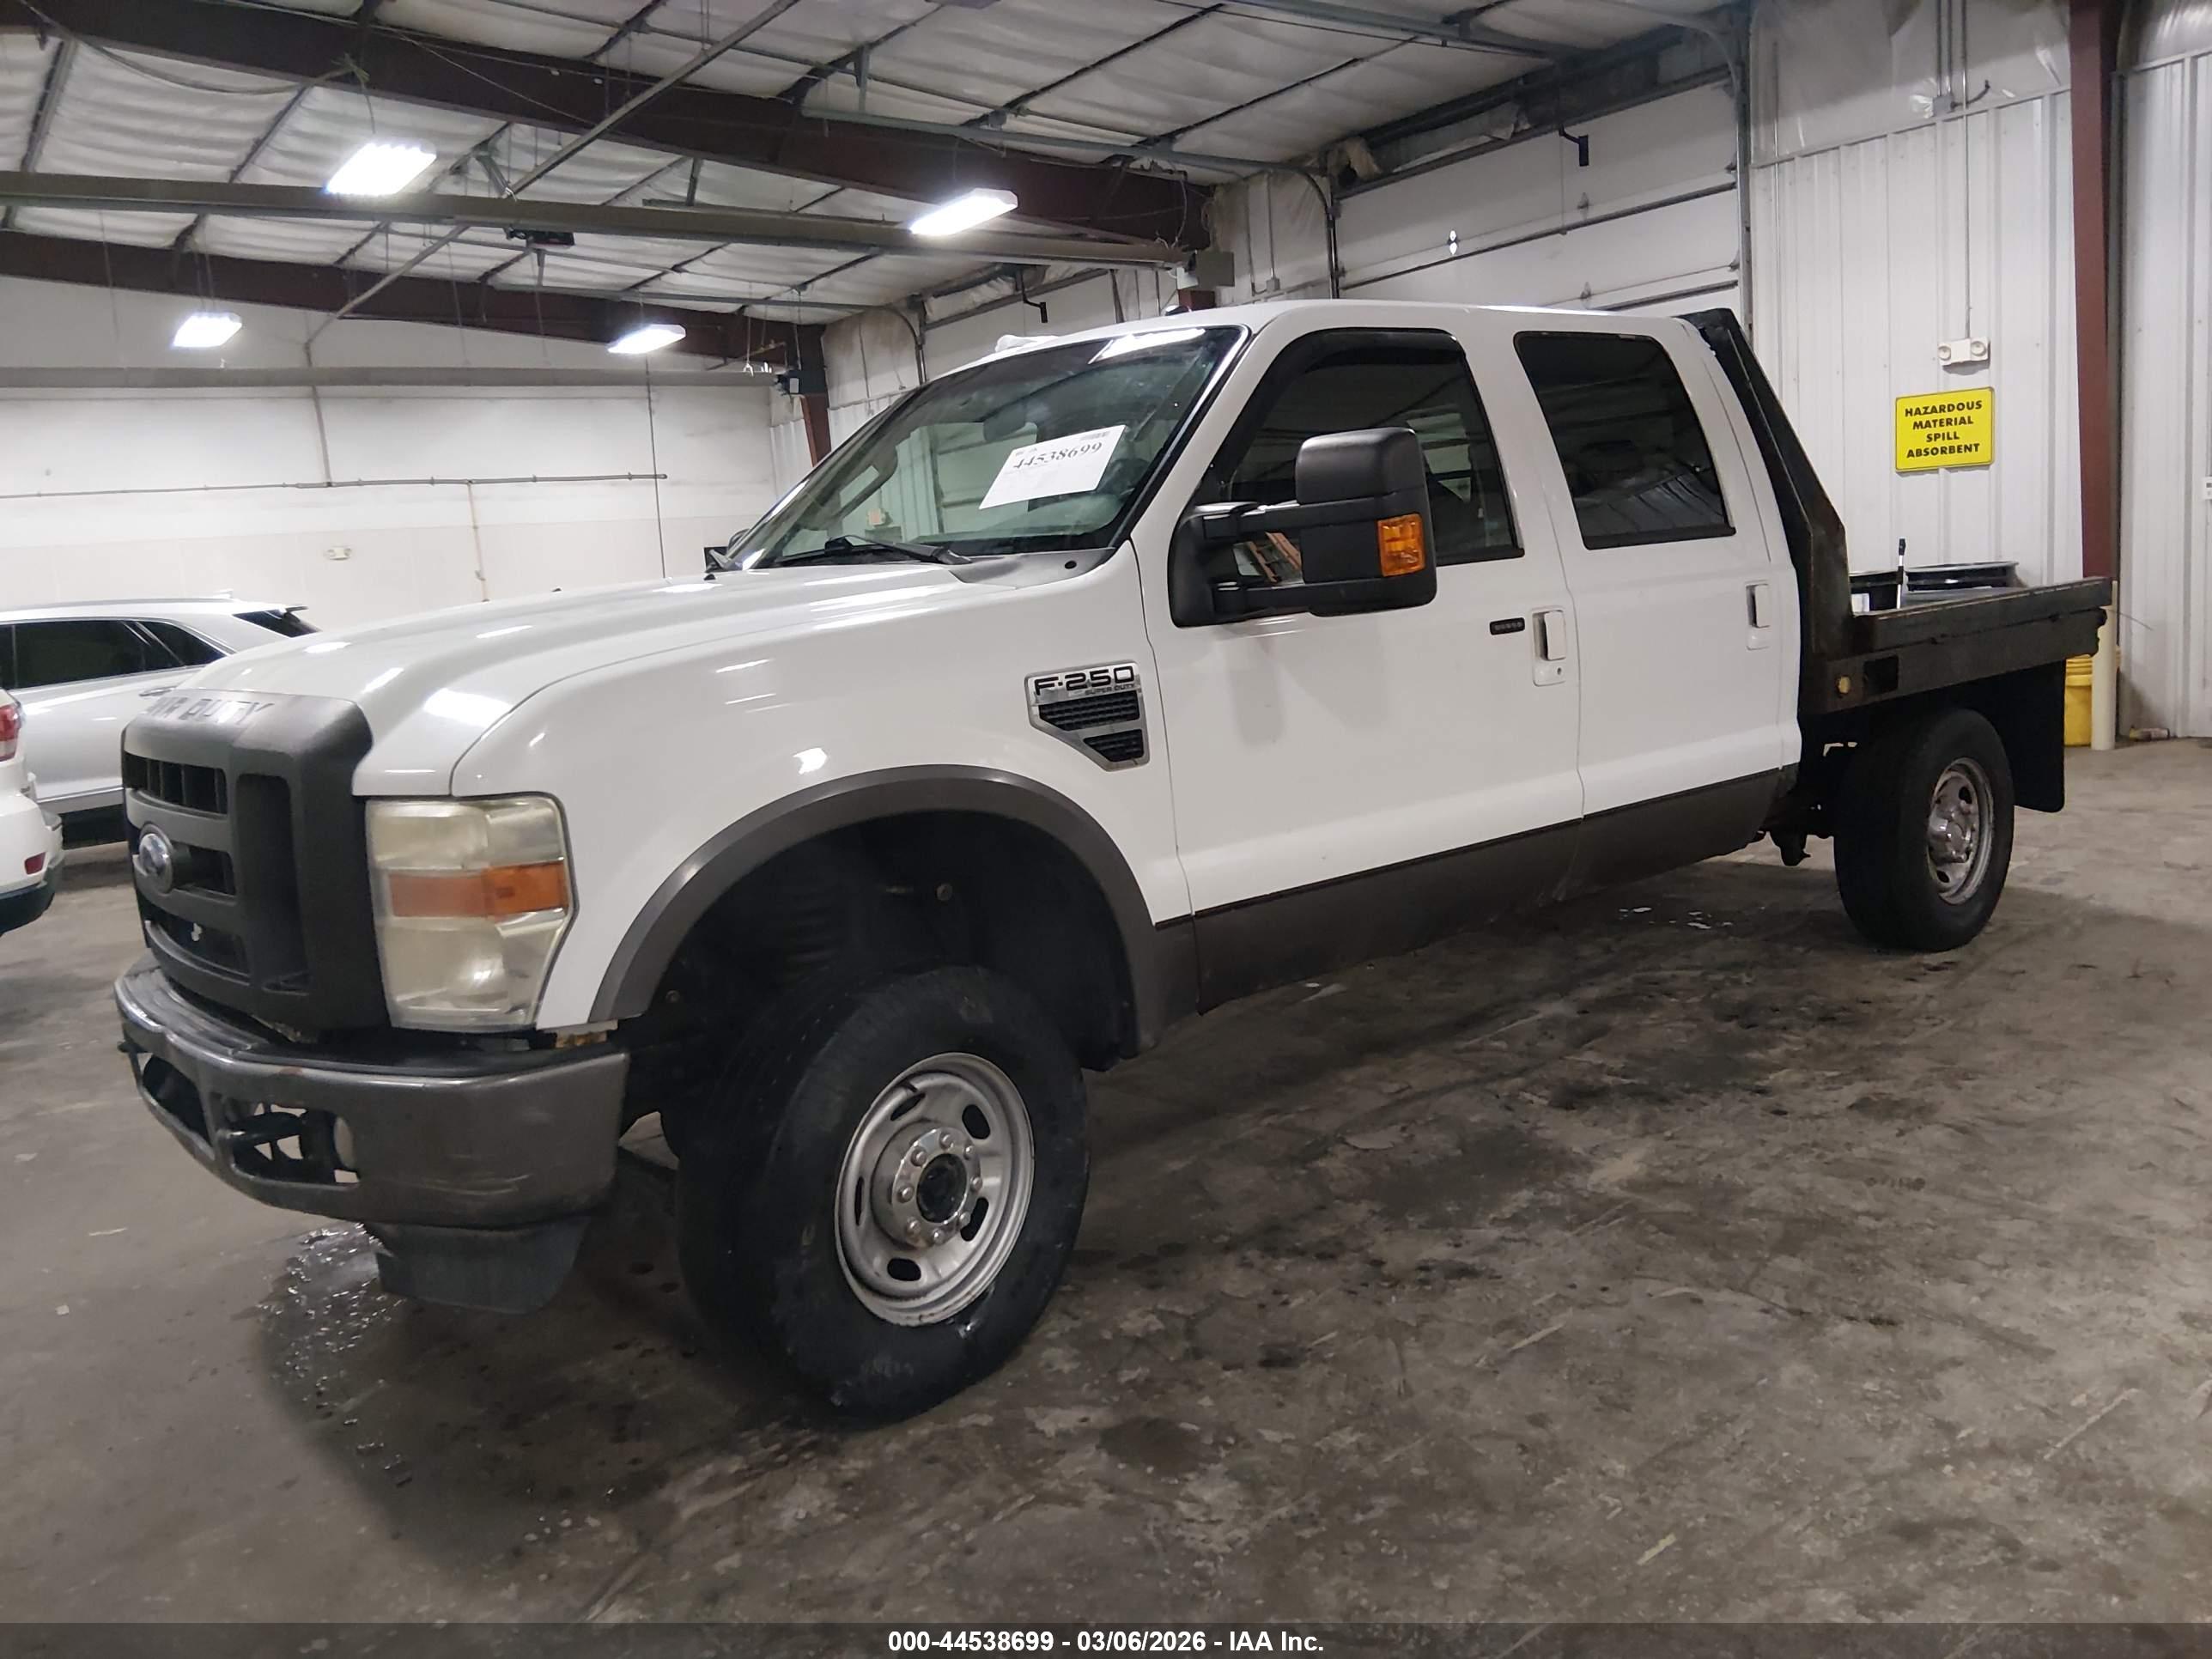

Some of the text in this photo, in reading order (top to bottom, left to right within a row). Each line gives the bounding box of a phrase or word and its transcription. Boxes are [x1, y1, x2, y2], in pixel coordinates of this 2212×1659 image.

[1905, 400, 1983, 417] HAZARDOUS
[1912, 416, 1973, 430] MATERIAL
[1926, 431, 1960, 442] SPILL
[1906, 443, 1980, 459] ABSORBENT
